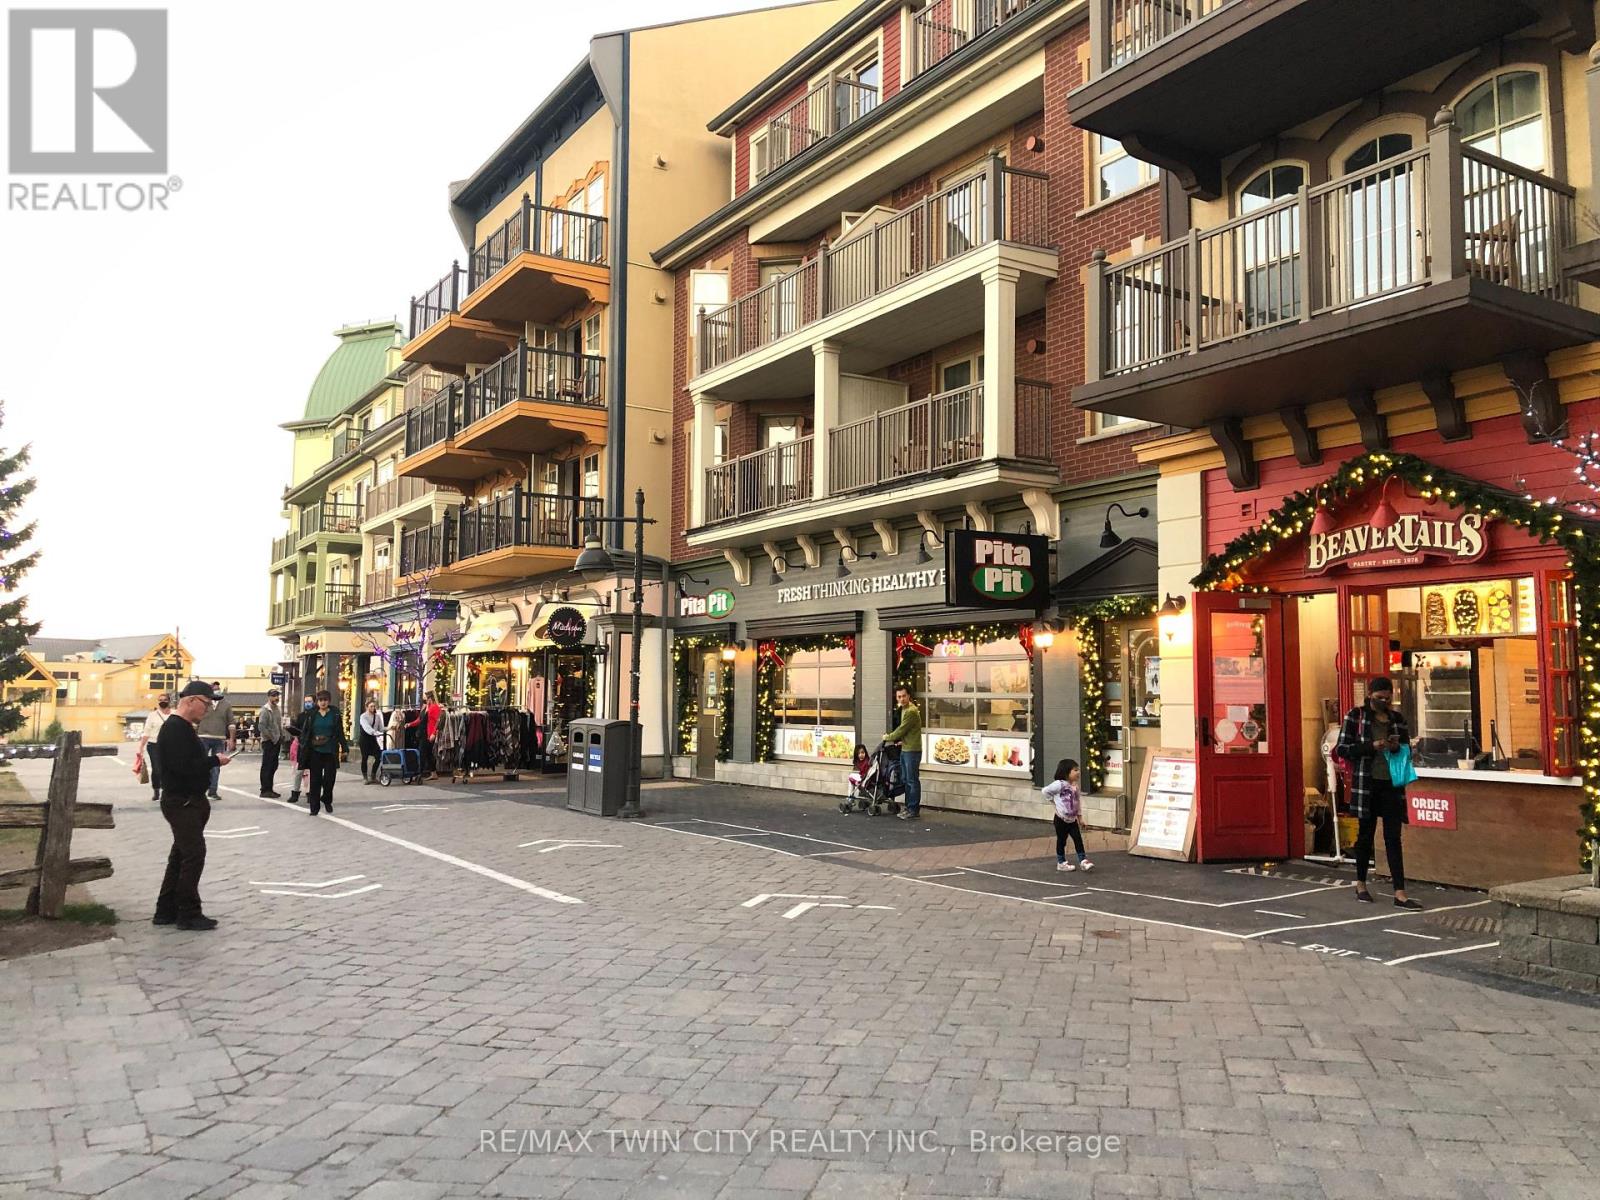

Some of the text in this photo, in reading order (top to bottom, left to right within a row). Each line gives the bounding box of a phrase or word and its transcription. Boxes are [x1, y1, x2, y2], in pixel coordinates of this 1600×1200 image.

[975, 539, 1031, 566] Pita
[1353, 560, 1377, 568] PASTRY
[1382, 558, 1401, 566] SINCE
[777, 585, 812, 603] FRESH
[812, 577, 870, 599] THINKING
[872, 570, 937, 593] HEALTHY
[984, 567, 1024, 593] Pit
[680, 593, 728, 616] Pita Pit
[1411, 797, 1449, 811] ORDER
[1417, 809, 1445, 822] HERE
[1300, 943, 1361, 957] EXIT
